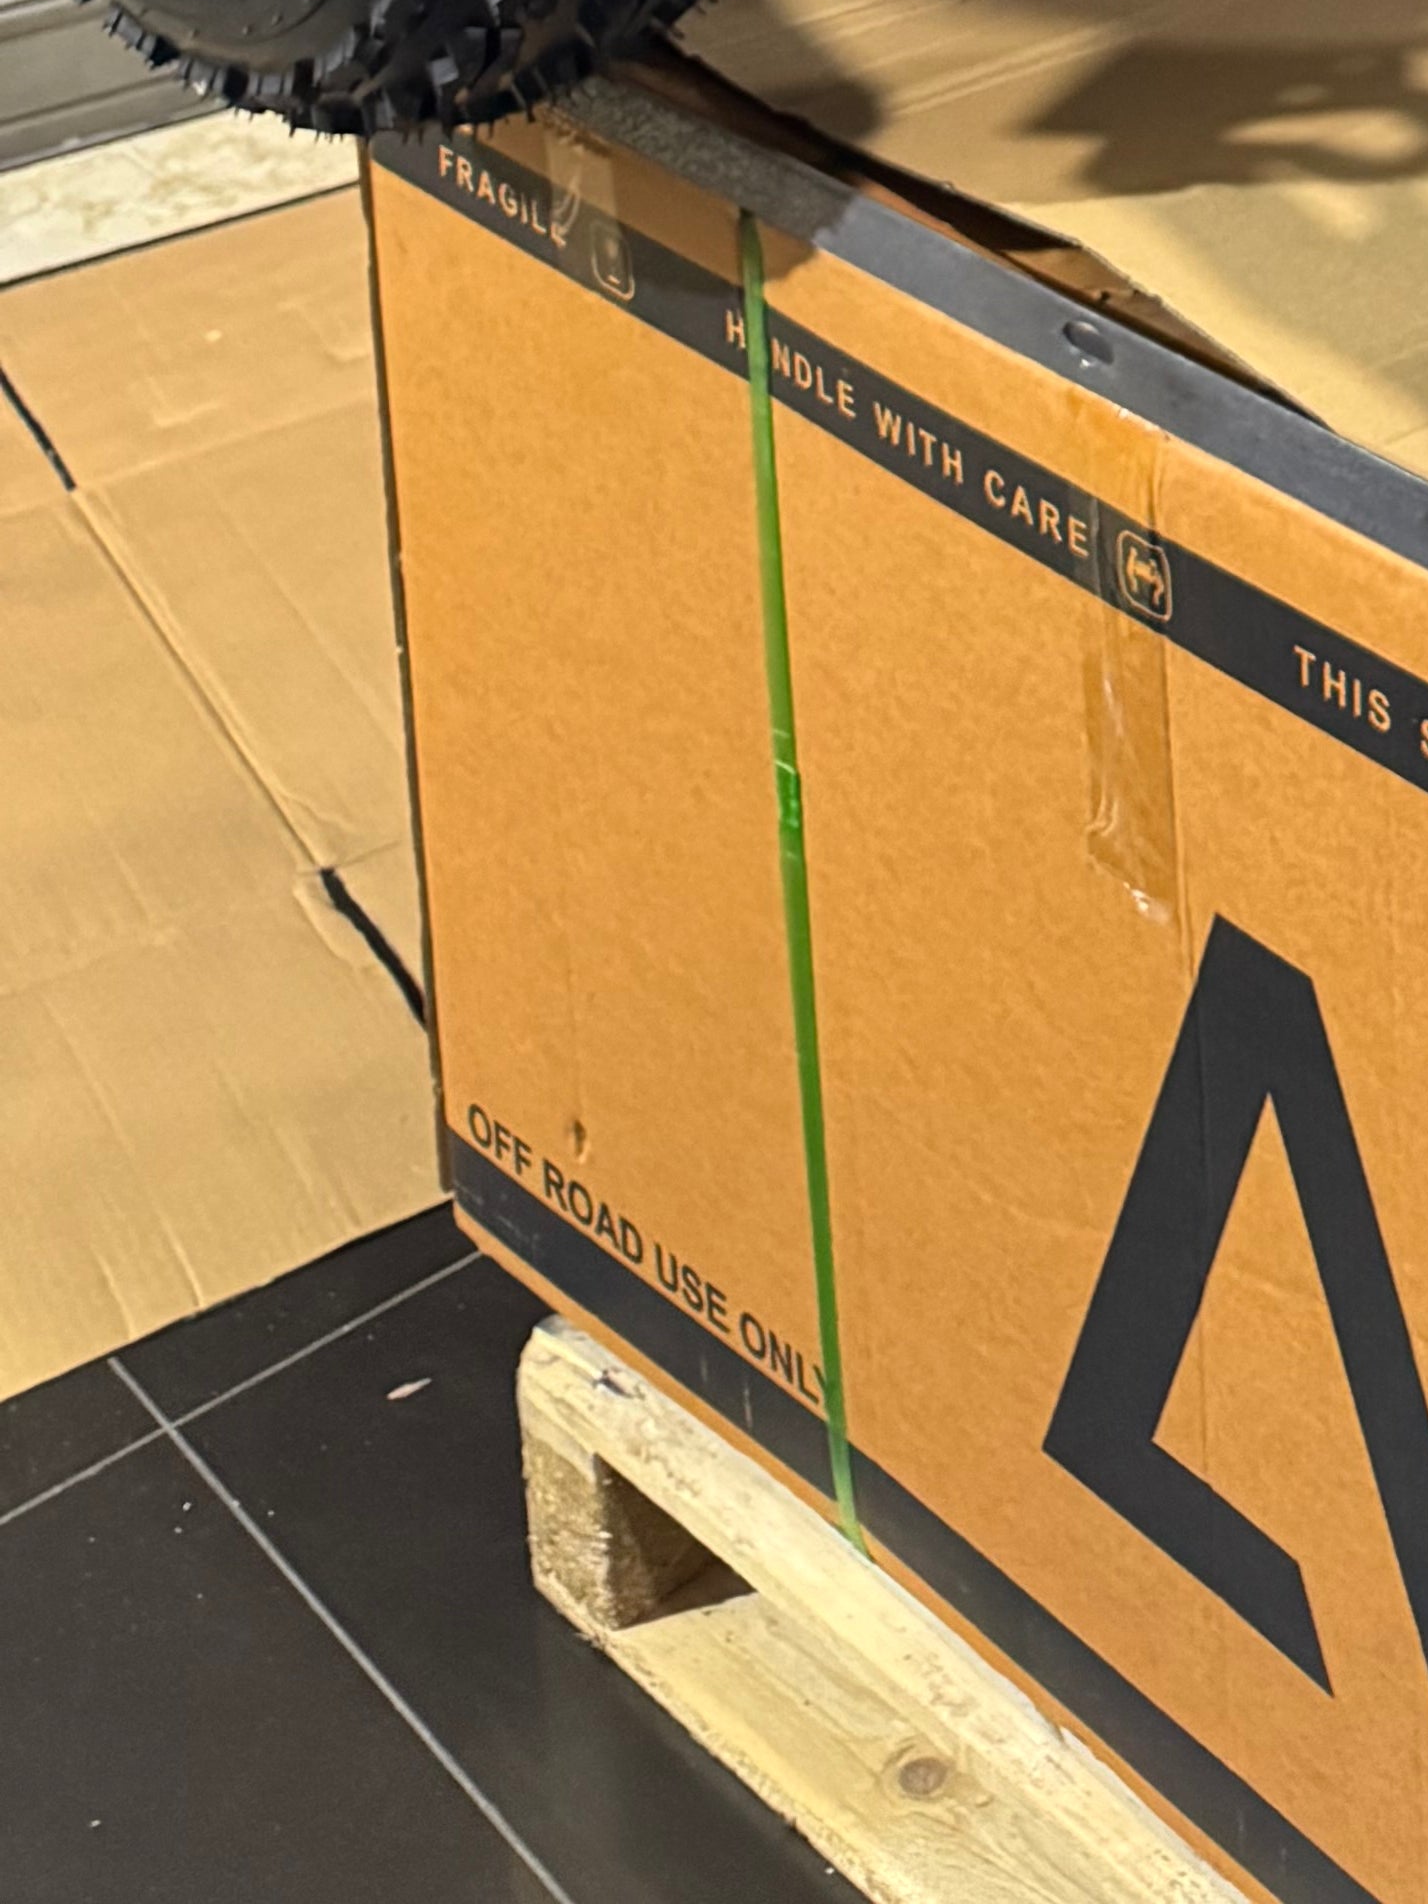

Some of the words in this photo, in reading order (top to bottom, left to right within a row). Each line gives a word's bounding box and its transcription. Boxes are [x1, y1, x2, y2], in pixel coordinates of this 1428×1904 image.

[726, 310, 857, 418] HNDLE
[873, 400, 964, 486] WITH
[983, 470, 1090, 559] CARE
[1293, 645, 1393, 733] THIS
[468, 1103, 533, 1176] OFF
[543, 1158, 644, 1265] ROAD
[655, 1242, 731, 1335] USE
